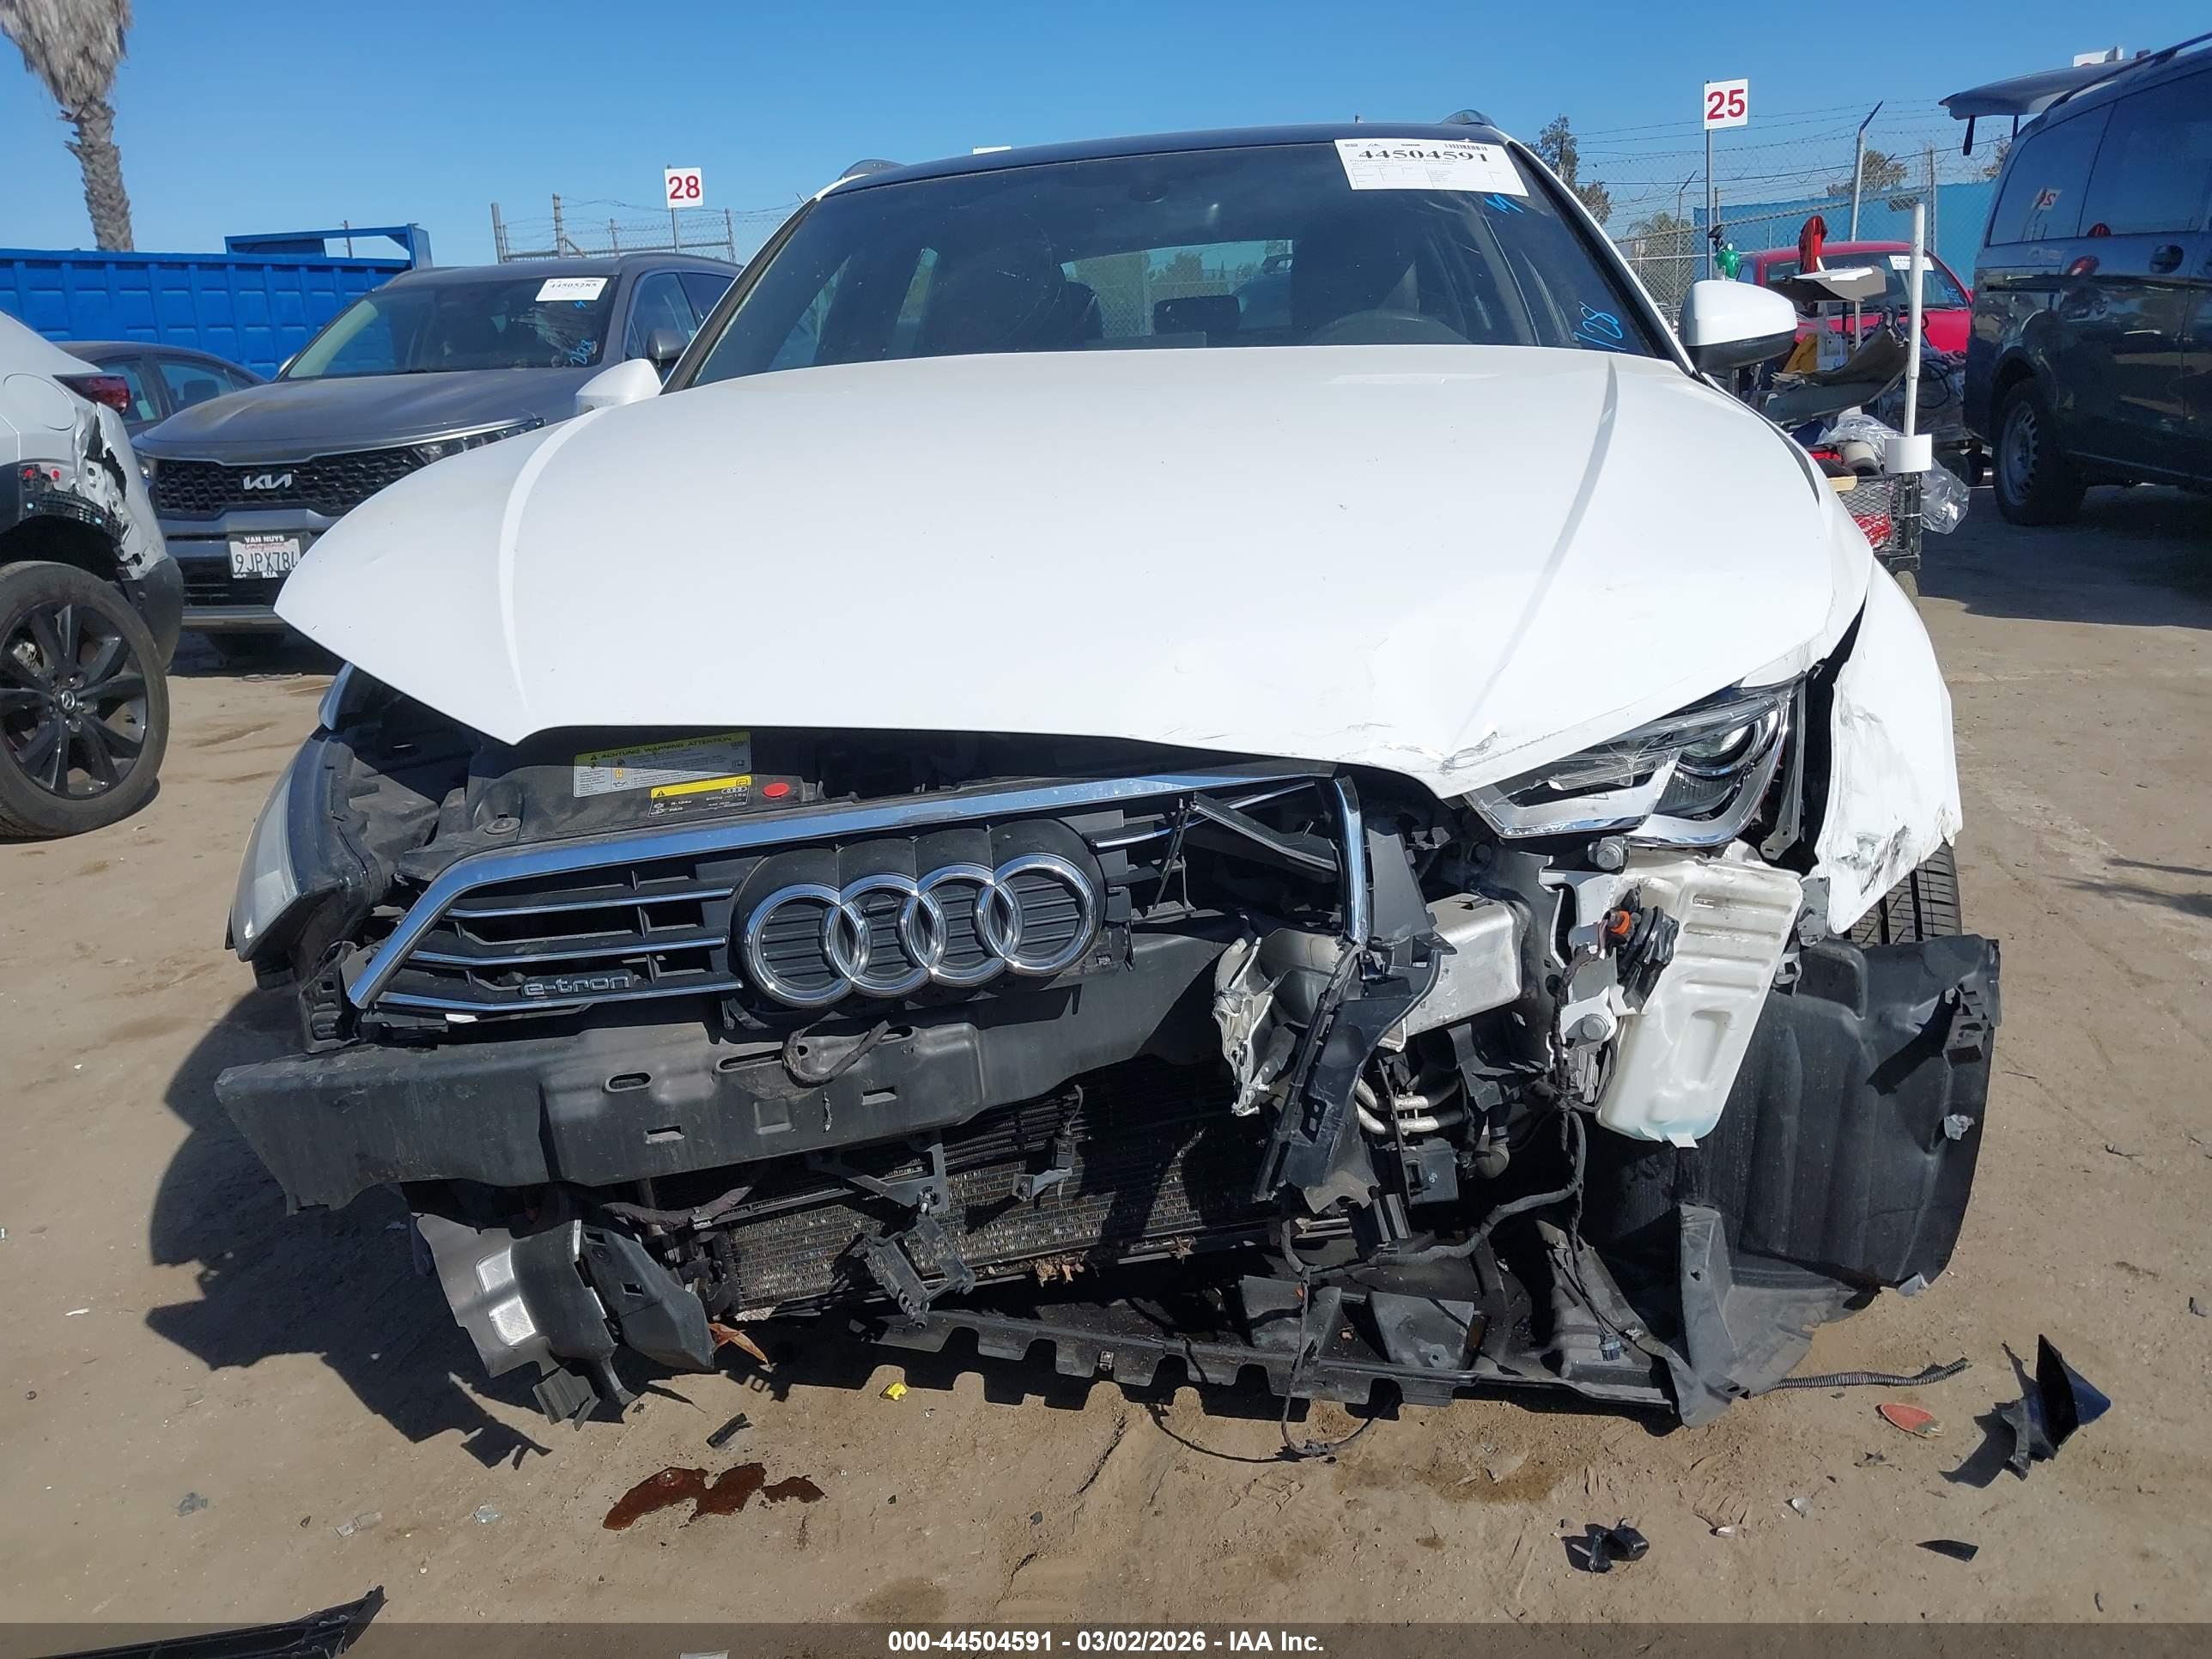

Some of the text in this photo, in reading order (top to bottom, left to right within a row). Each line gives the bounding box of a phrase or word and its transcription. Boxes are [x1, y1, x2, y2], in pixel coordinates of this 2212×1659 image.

[1707, 88, 1746, 120] 25
[1358, 149, 1490, 162] 44504591
[670, 175, 700, 200] 28
[243, 474, 293, 490] KIA
[261, 570, 279, 579] KIA
[601, 736, 732, 759] ACHTUNG WARNING ATTENTION
[524, 976, 629, 996] e-tron
